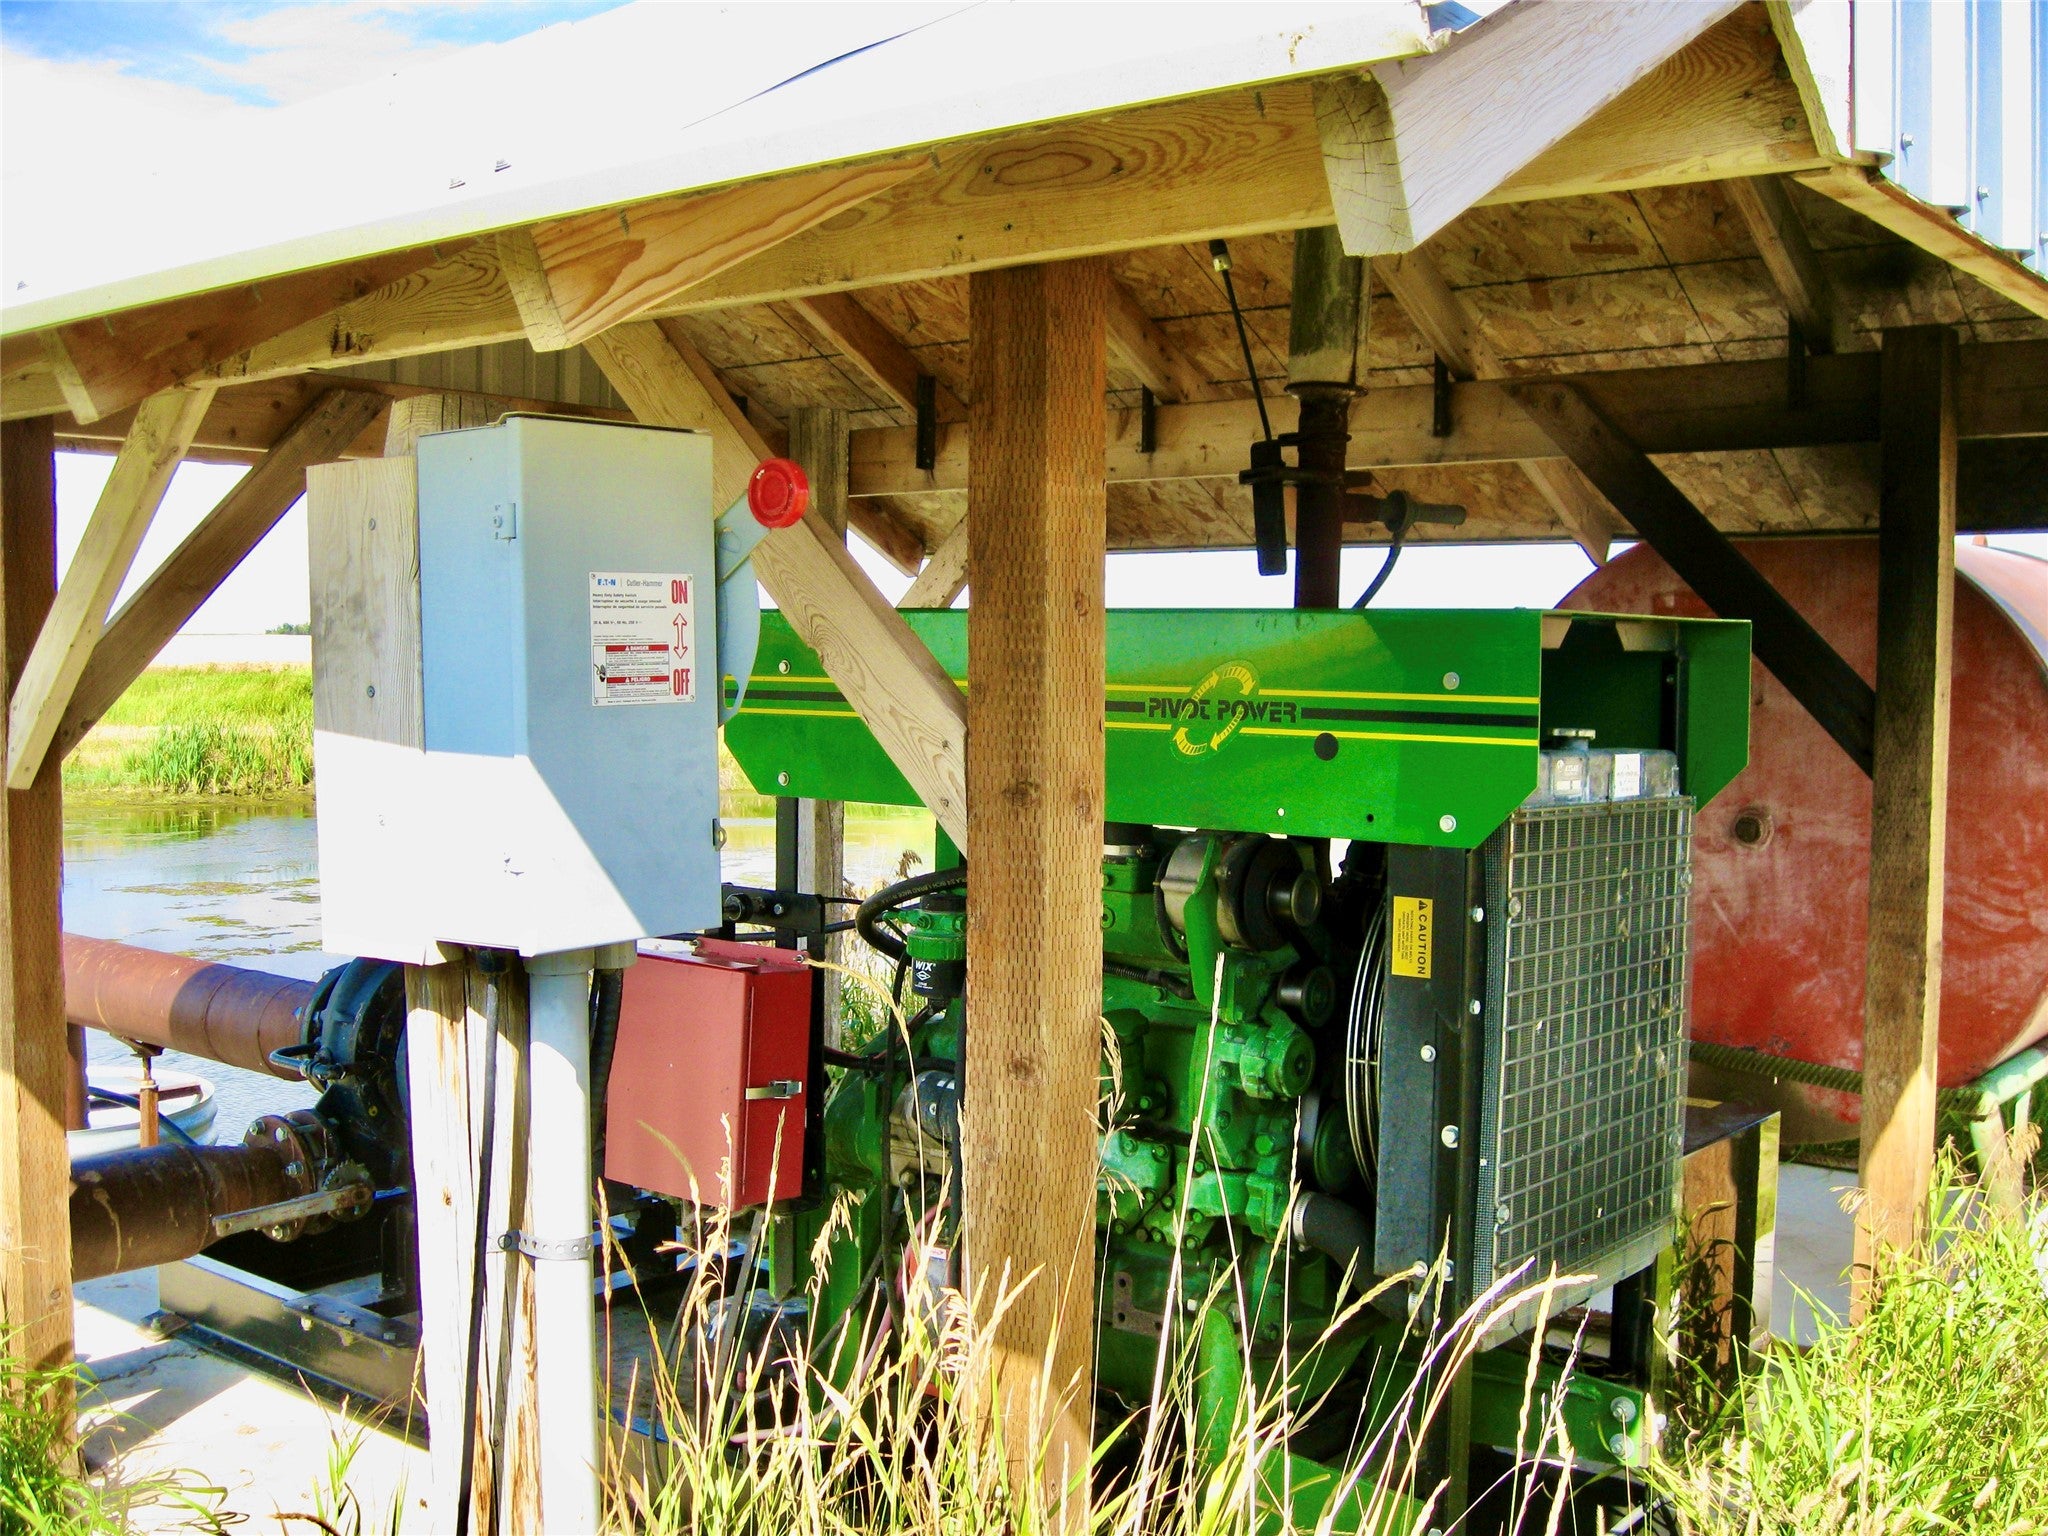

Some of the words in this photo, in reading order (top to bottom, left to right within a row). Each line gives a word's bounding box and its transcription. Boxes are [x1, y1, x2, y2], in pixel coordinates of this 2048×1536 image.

[671, 579, 688, 604] ON
[673, 668, 690, 696] OFF
[1148, 698, 1210, 720] PIVOT
[1218, 700, 1298, 723] POWER
[1418, 914, 1427, 975] CAUTION
[915, 960, 933, 972] WIX
